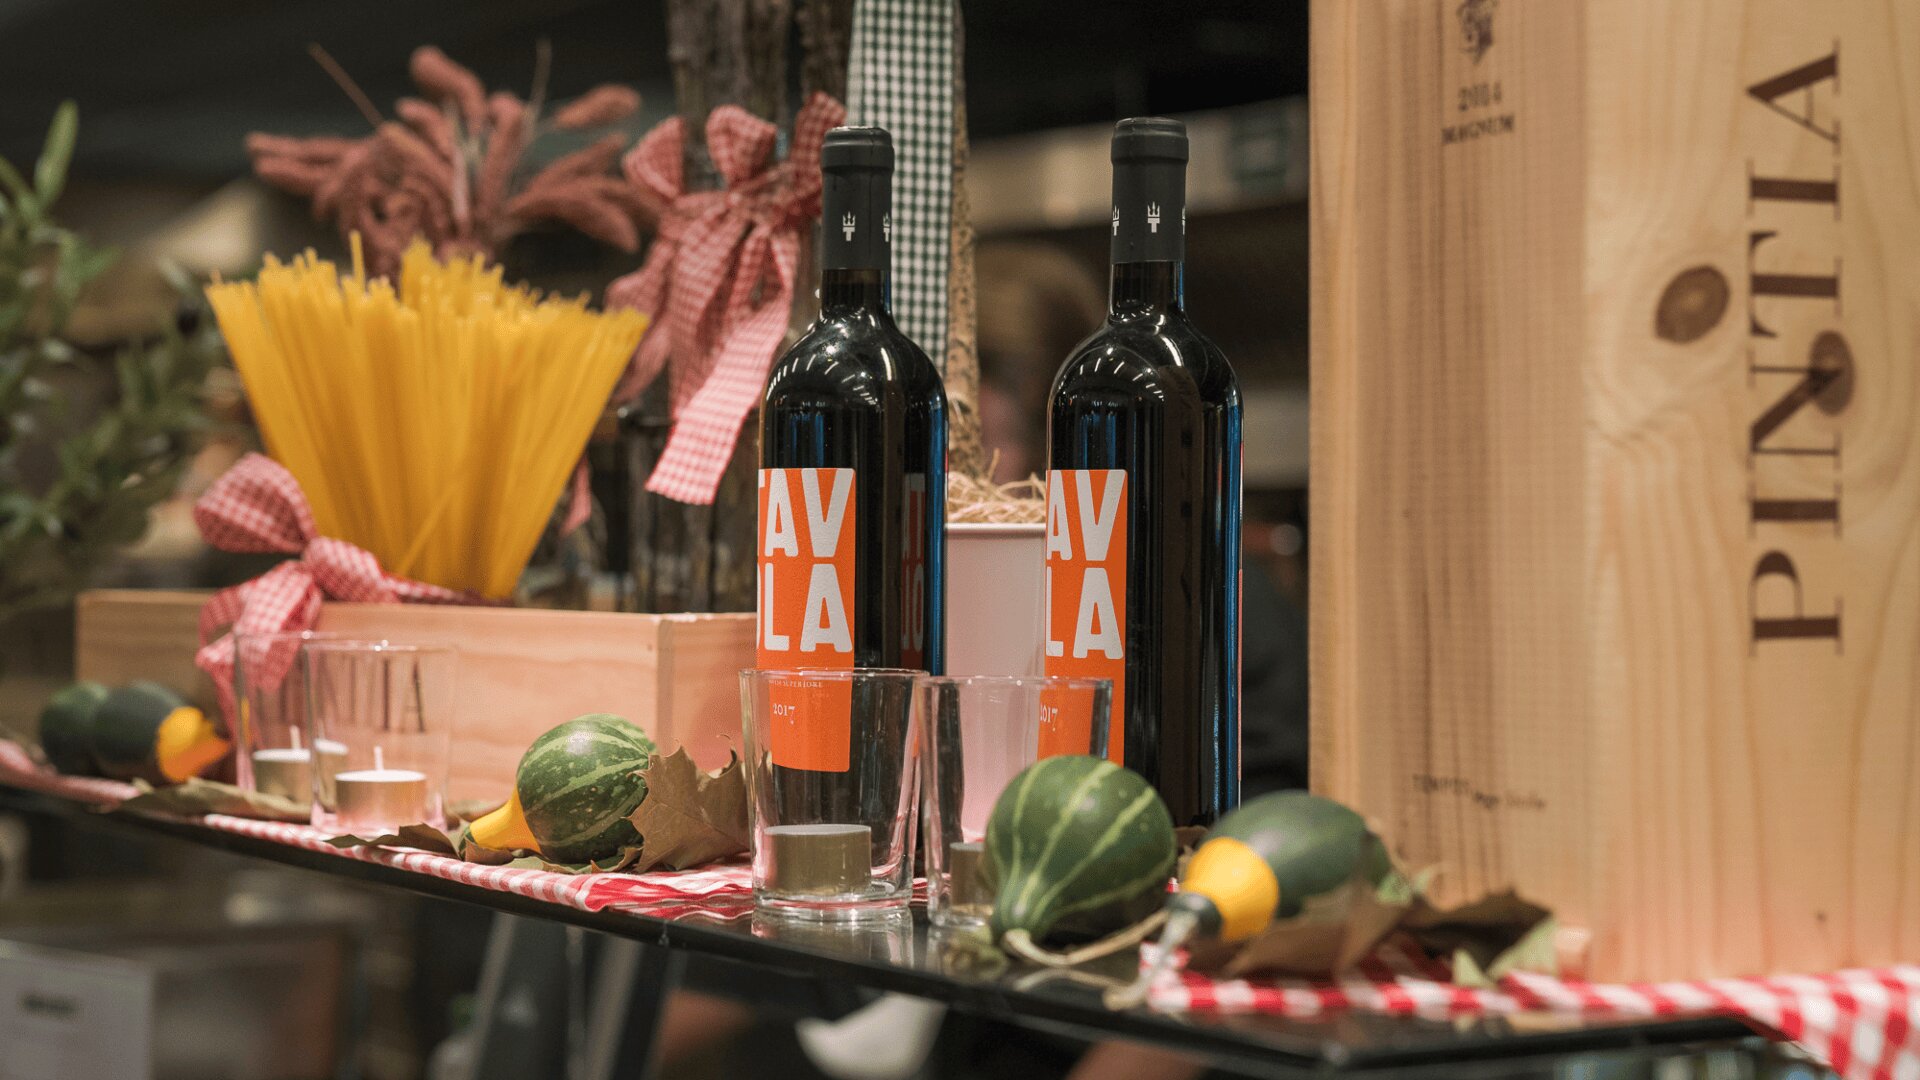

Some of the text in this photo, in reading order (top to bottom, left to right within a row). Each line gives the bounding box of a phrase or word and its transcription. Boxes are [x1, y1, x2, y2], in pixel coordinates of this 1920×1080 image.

[1441, 113, 1515, 145] MAGNUM
[1746, 38, 1844, 658] PINTIA
[757, 563, 853, 653] LA
[1046, 566, 1123, 659] LA
[773, 704, 795, 725] 2017
